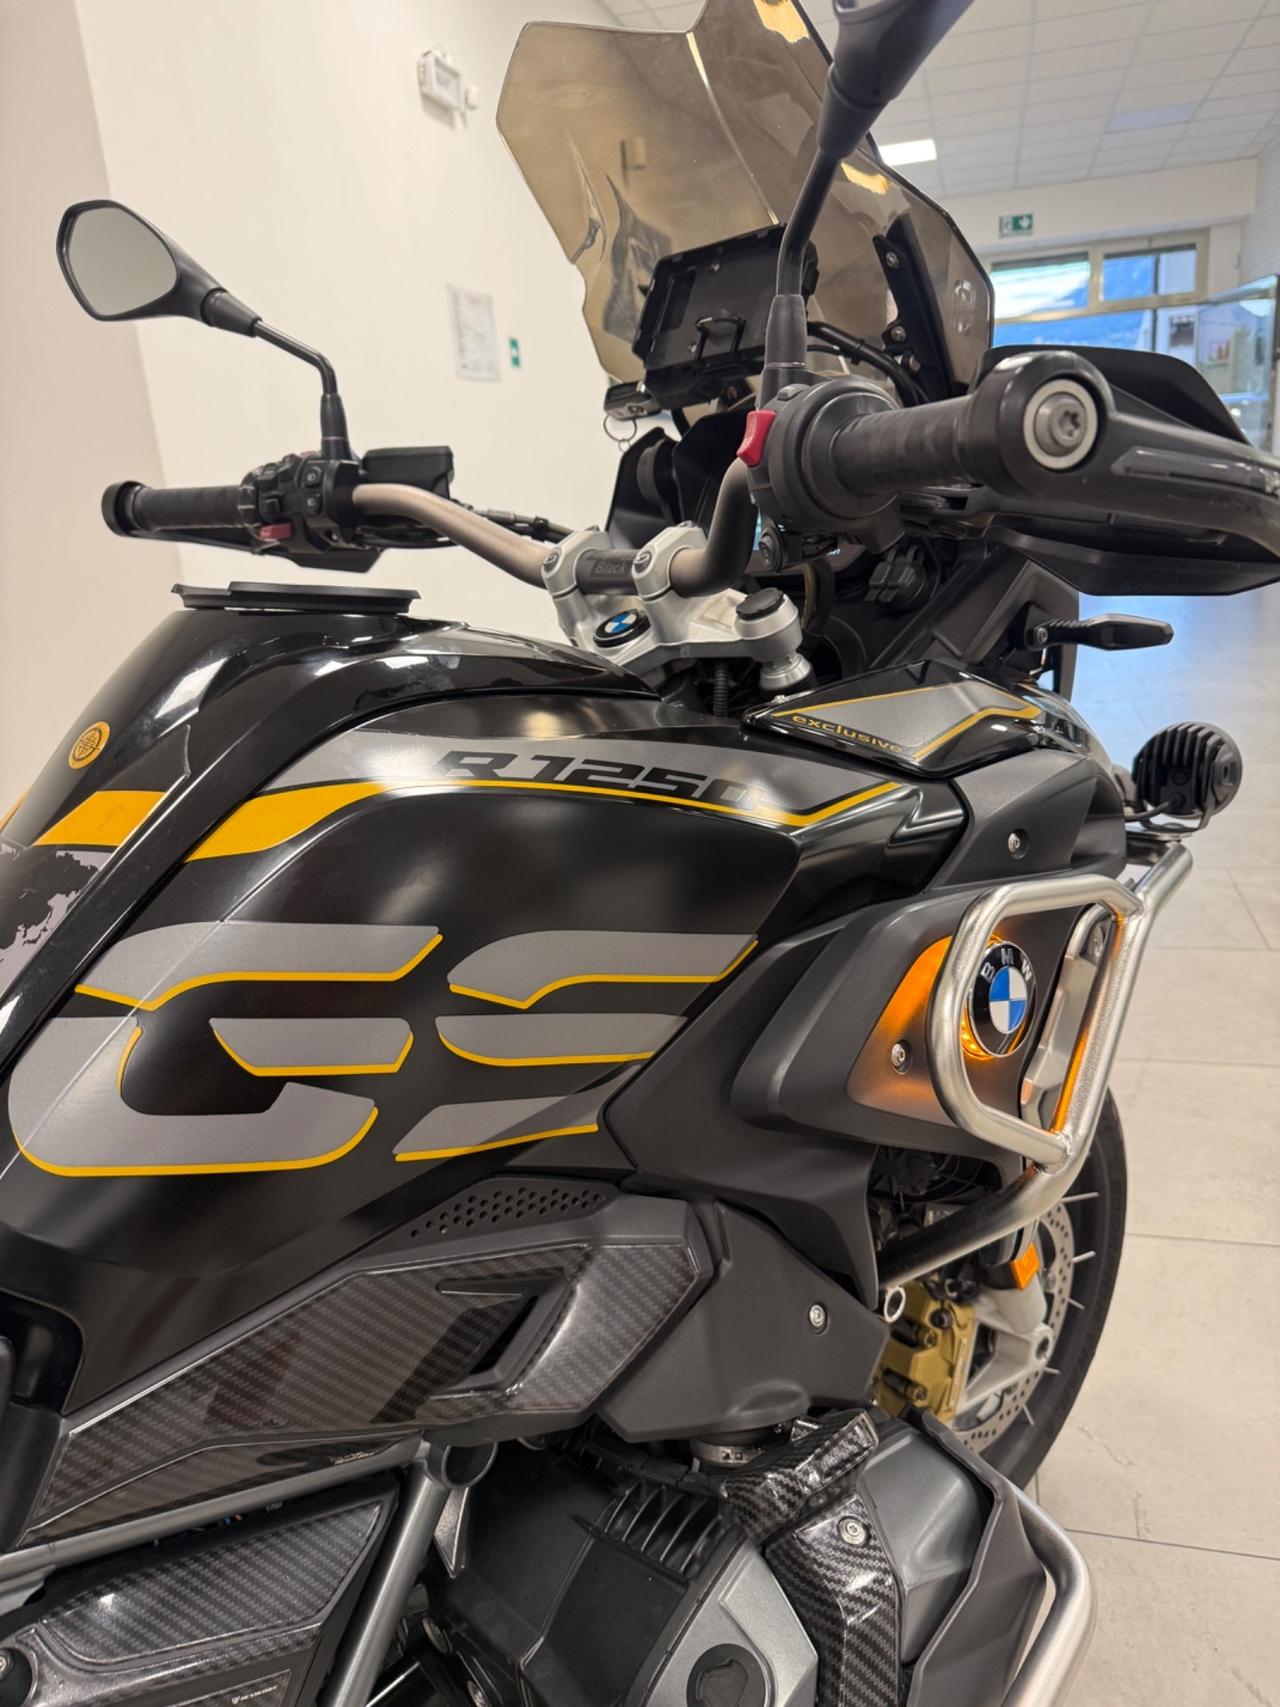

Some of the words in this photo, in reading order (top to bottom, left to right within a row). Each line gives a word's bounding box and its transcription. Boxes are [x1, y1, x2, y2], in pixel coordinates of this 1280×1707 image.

[594, 560, 626, 575] Black
[791, 714, 903, 753] exclusive
[437, 750, 517, 780] R
[513, 753, 767, 810] 1250
[980, 947, 1033, 984] BMW
